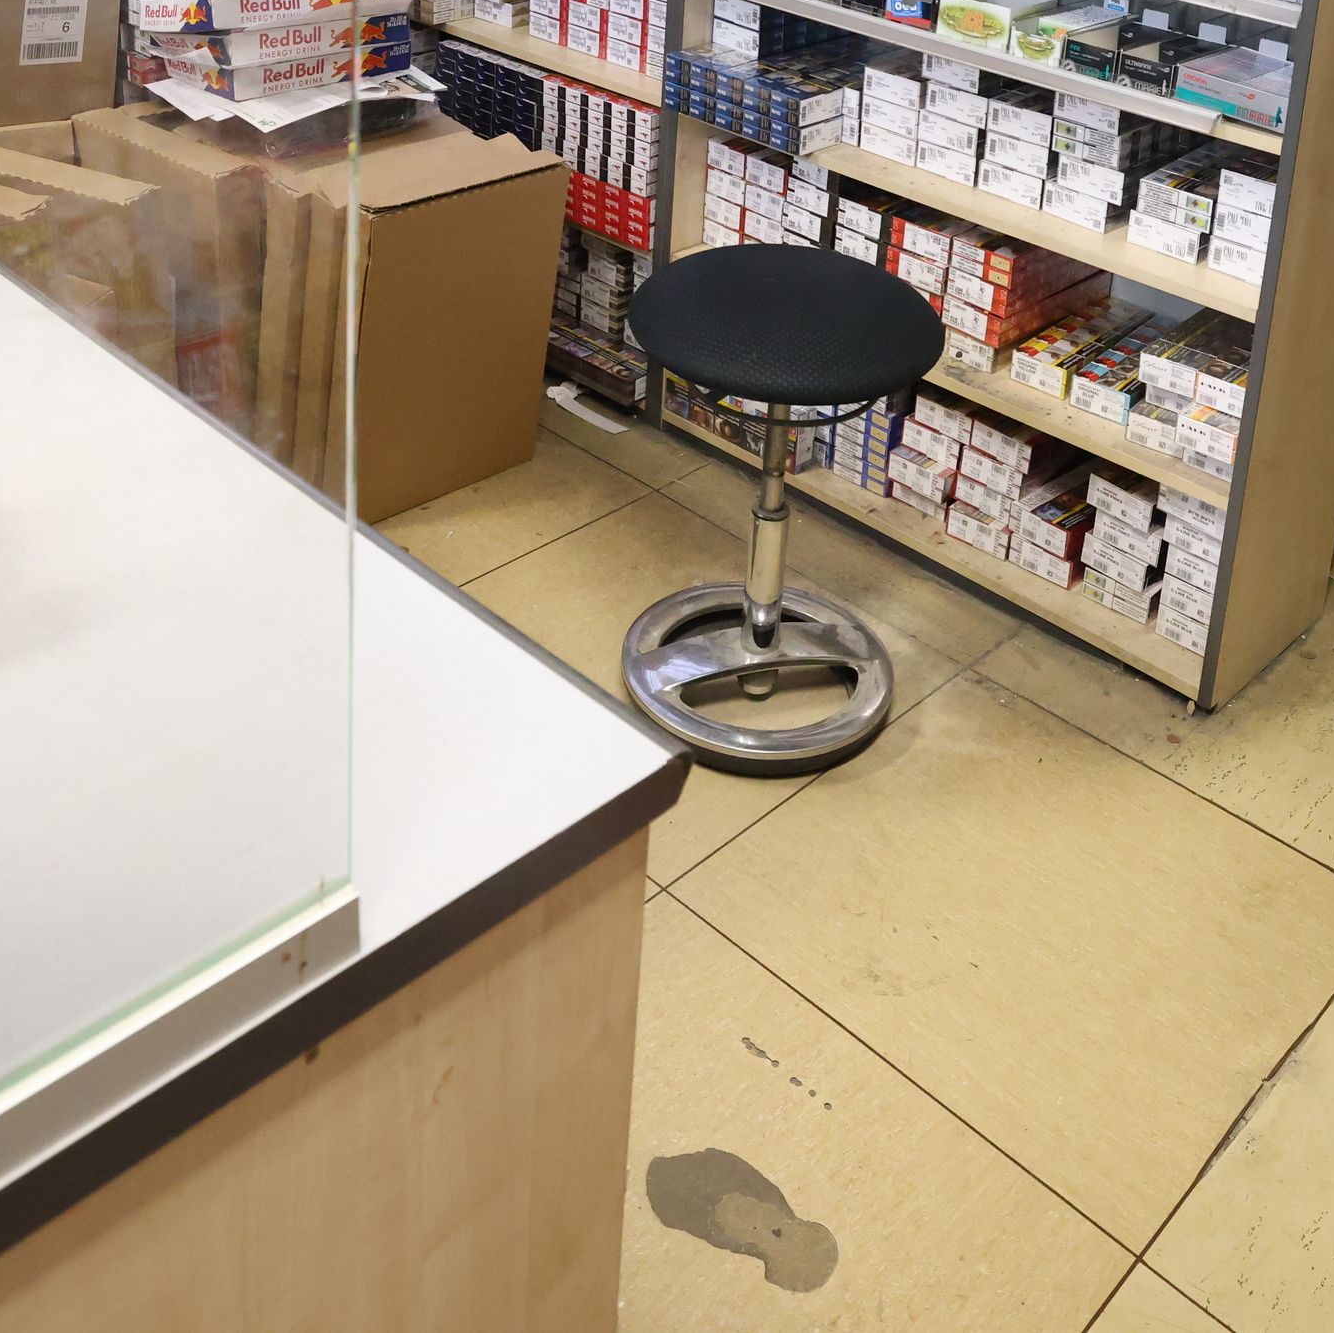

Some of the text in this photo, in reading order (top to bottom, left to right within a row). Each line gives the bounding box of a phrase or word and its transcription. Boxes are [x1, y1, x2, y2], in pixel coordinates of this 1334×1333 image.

[145, 4, 177, 18] Red Bull
[259, 26, 322, 49] Red Bull
[259, 46, 321, 59] ENERGY DRINK
[263, 59, 325, 84] Red Bull
[263, 77, 324, 93] ENERGY DRINK
